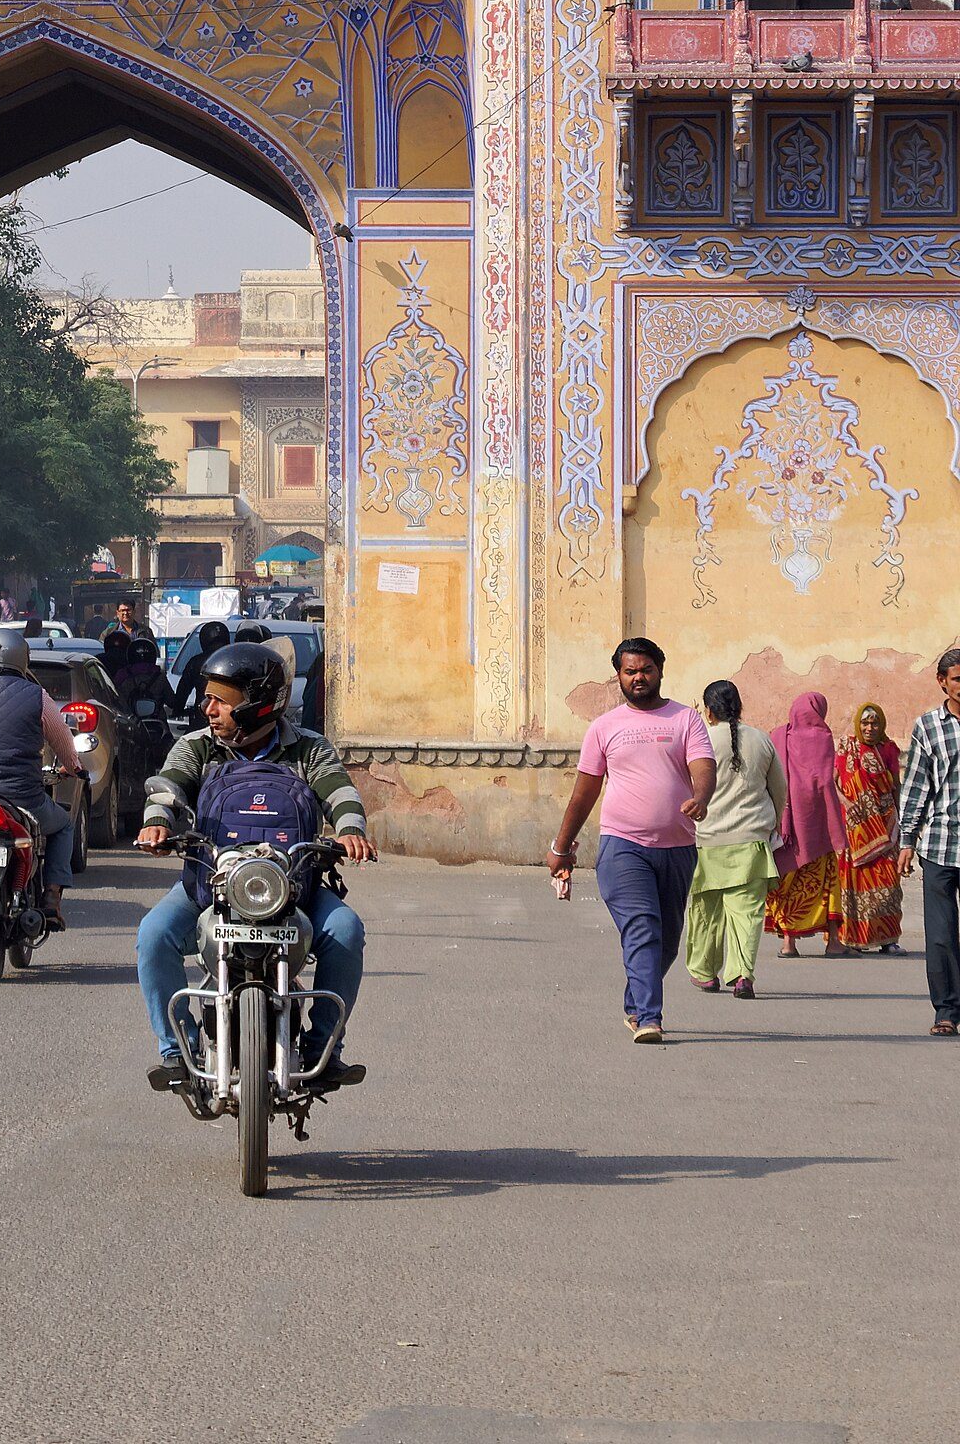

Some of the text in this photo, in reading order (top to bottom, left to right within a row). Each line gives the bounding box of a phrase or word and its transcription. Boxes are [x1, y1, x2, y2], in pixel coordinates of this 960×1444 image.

[214, 928, 297, 942] RJ14 SR 4347
